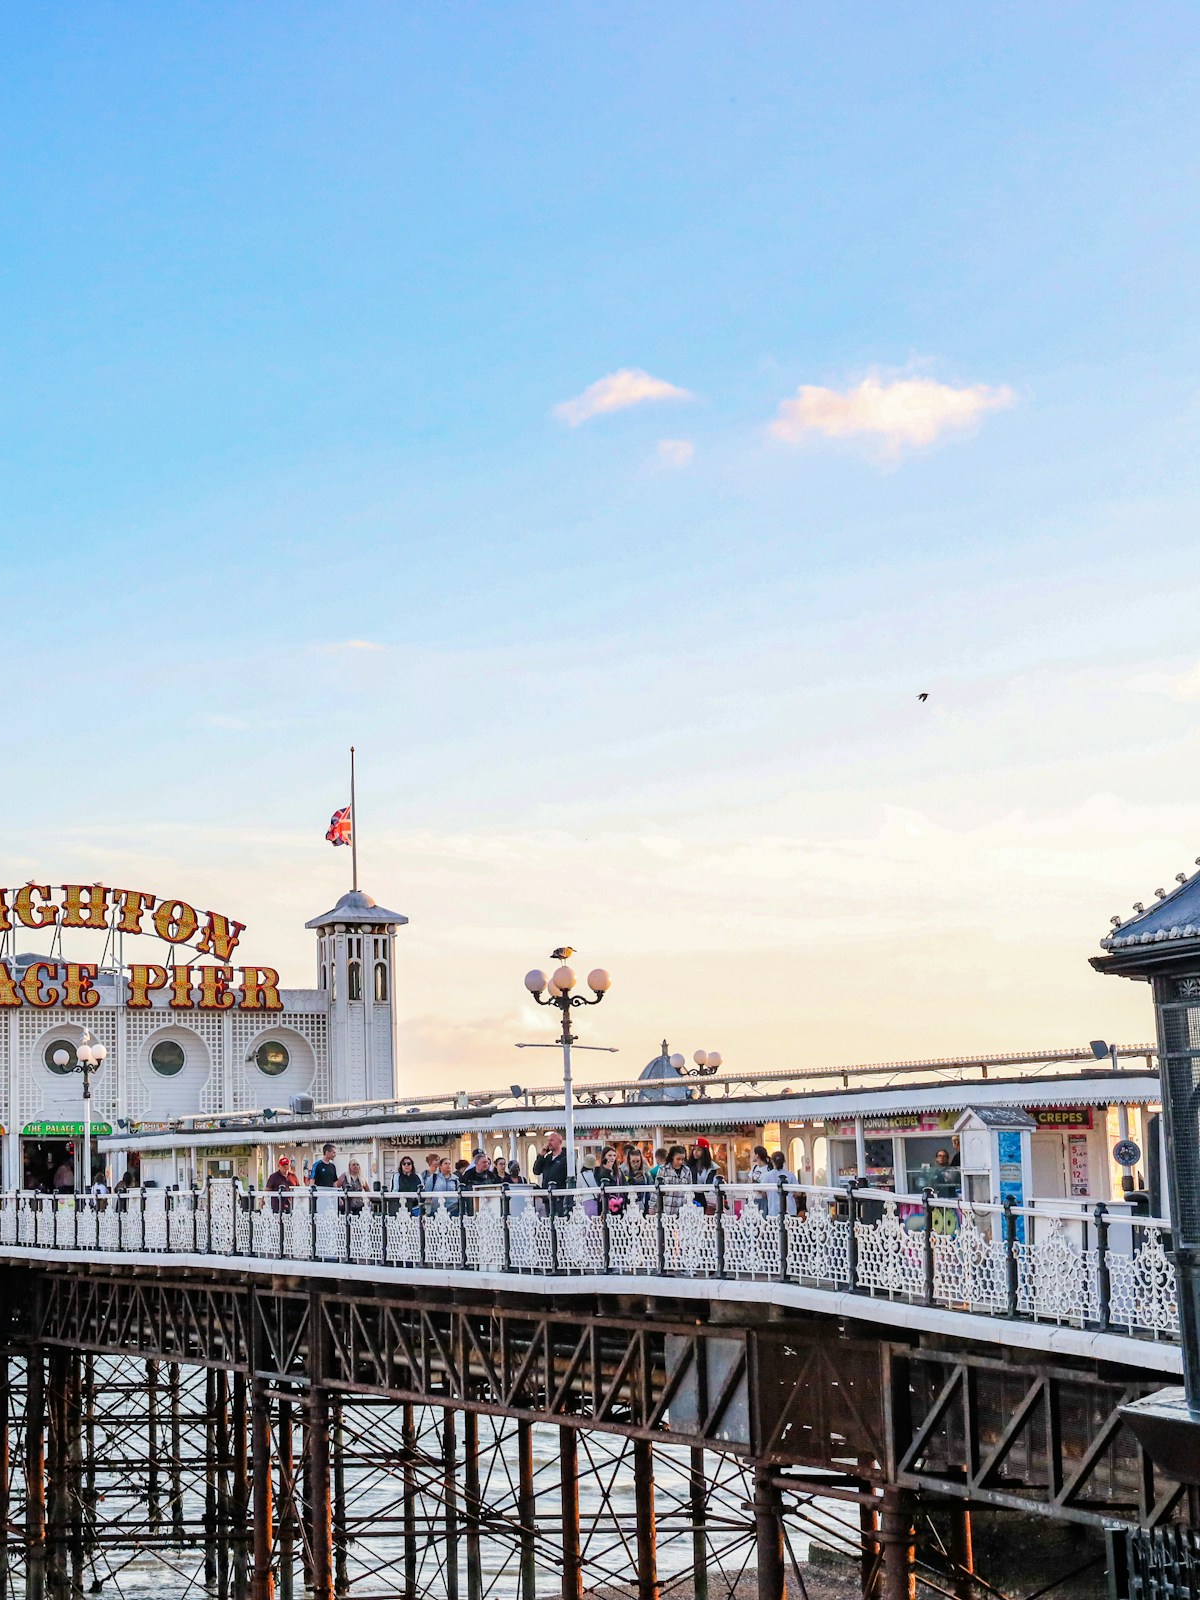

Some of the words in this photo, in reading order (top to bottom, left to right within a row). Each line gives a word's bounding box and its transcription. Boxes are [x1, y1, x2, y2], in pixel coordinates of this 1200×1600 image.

[126, 963, 284, 1012] PIER
[863, 1117, 889, 1128] DONUTS
[895, 1115, 918, 1127] CREPES
[1038, 1112, 1083, 1122] CREPES
[677, 1124, 711, 1133] CANDY
[715, 1124, 745, 1133] FLOSS
[391, 1136, 421, 1145] SLUSH
[424, 1135, 444, 1145] BAR
